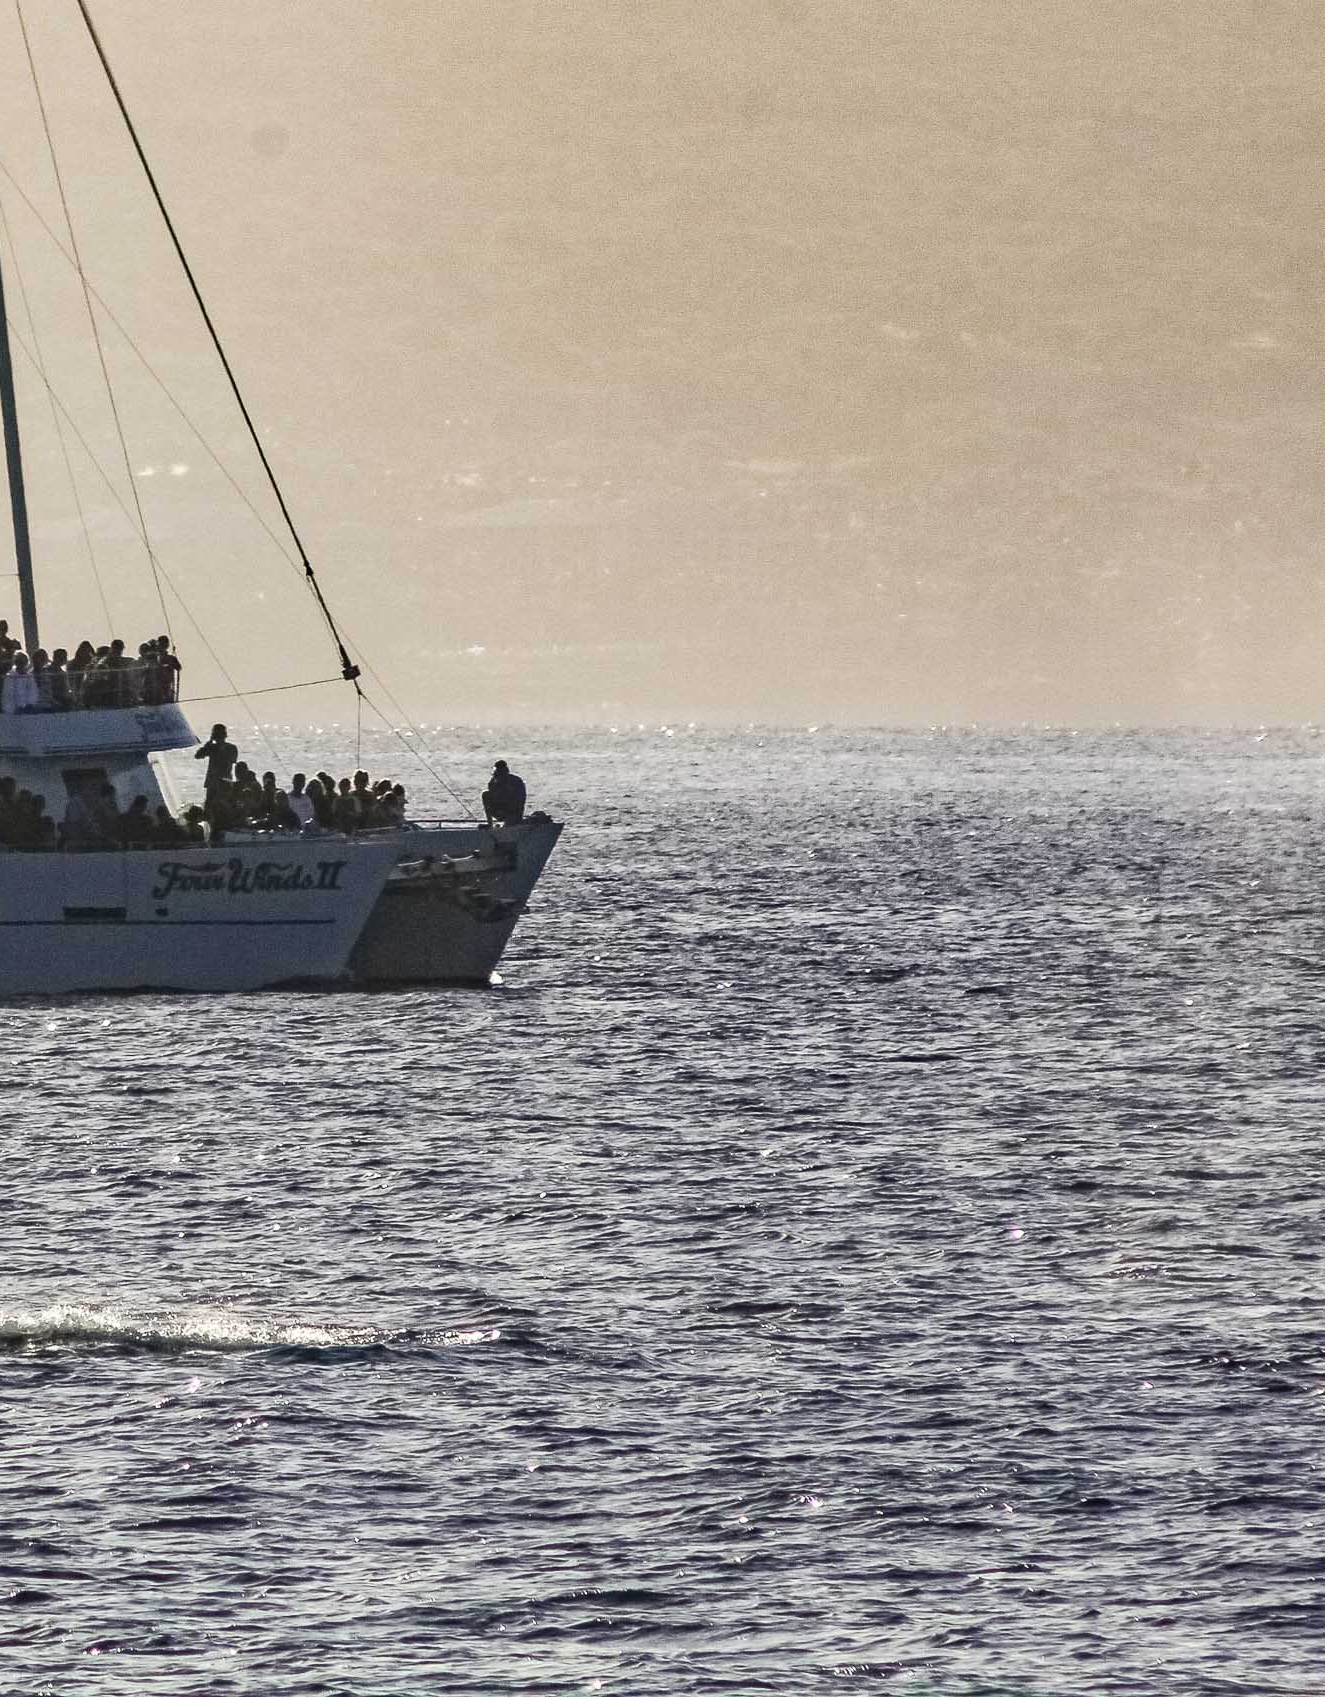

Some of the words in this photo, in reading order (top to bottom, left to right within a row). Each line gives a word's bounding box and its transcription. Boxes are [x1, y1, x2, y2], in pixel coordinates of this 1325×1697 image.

[152, 861, 226, 900] Four
[229, 857, 314, 894] Winds
[317, 860, 348, 890] II
